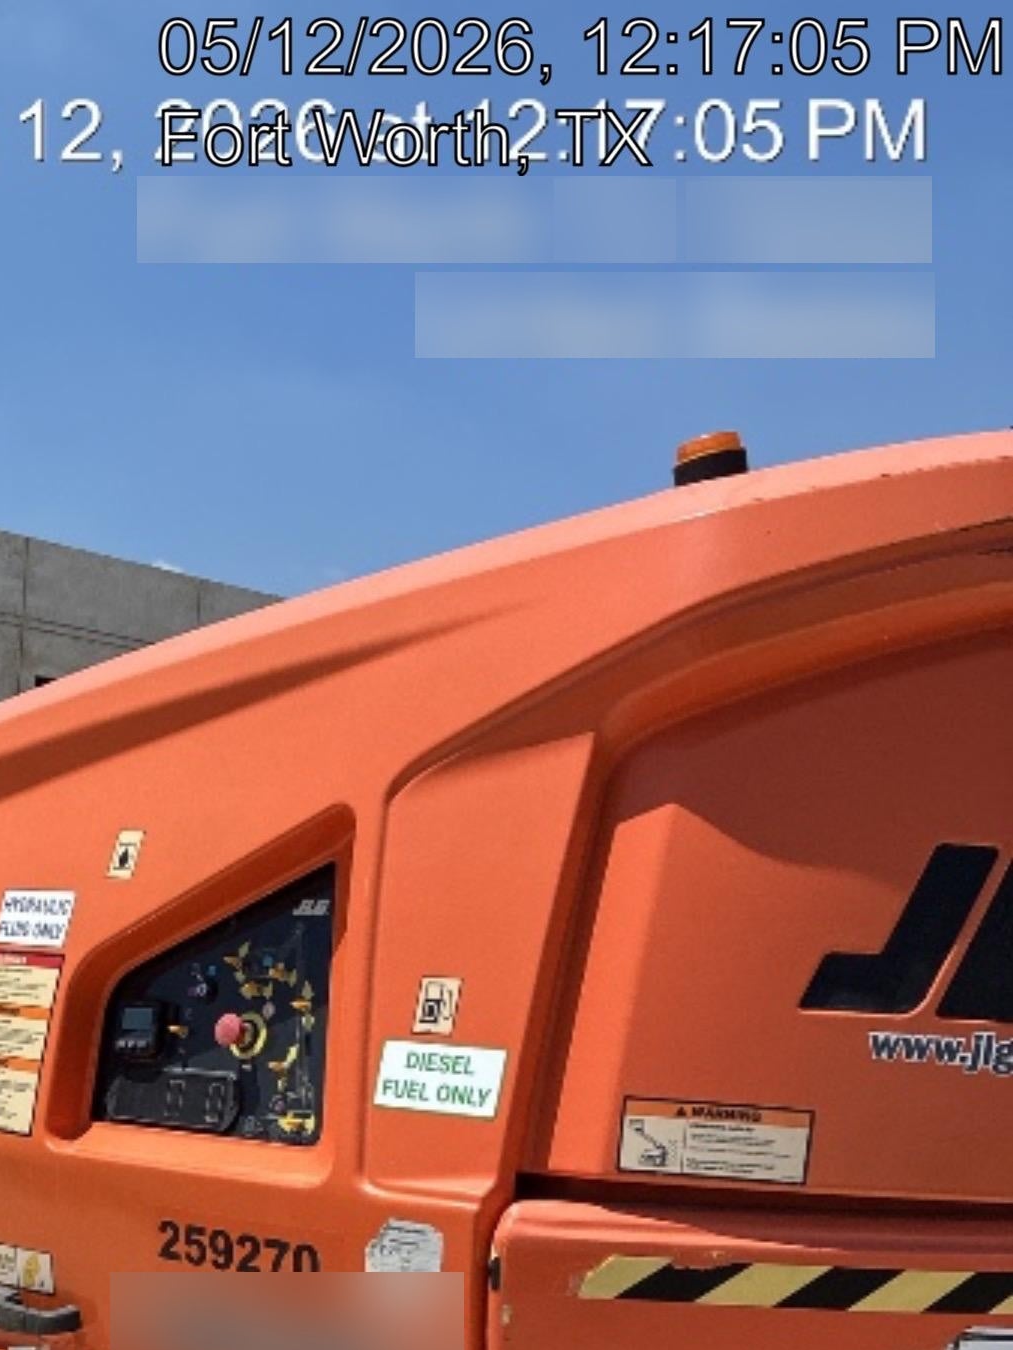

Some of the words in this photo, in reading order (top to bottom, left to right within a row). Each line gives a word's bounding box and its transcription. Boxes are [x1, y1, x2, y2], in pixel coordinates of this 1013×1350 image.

[404, 1050, 475, 1076] DIESEL
[382, 1079, 430, 1102] FUEL
[435, 1083, 492, 1108] ONLY
[157, 1219, 322, 1272] 259270
